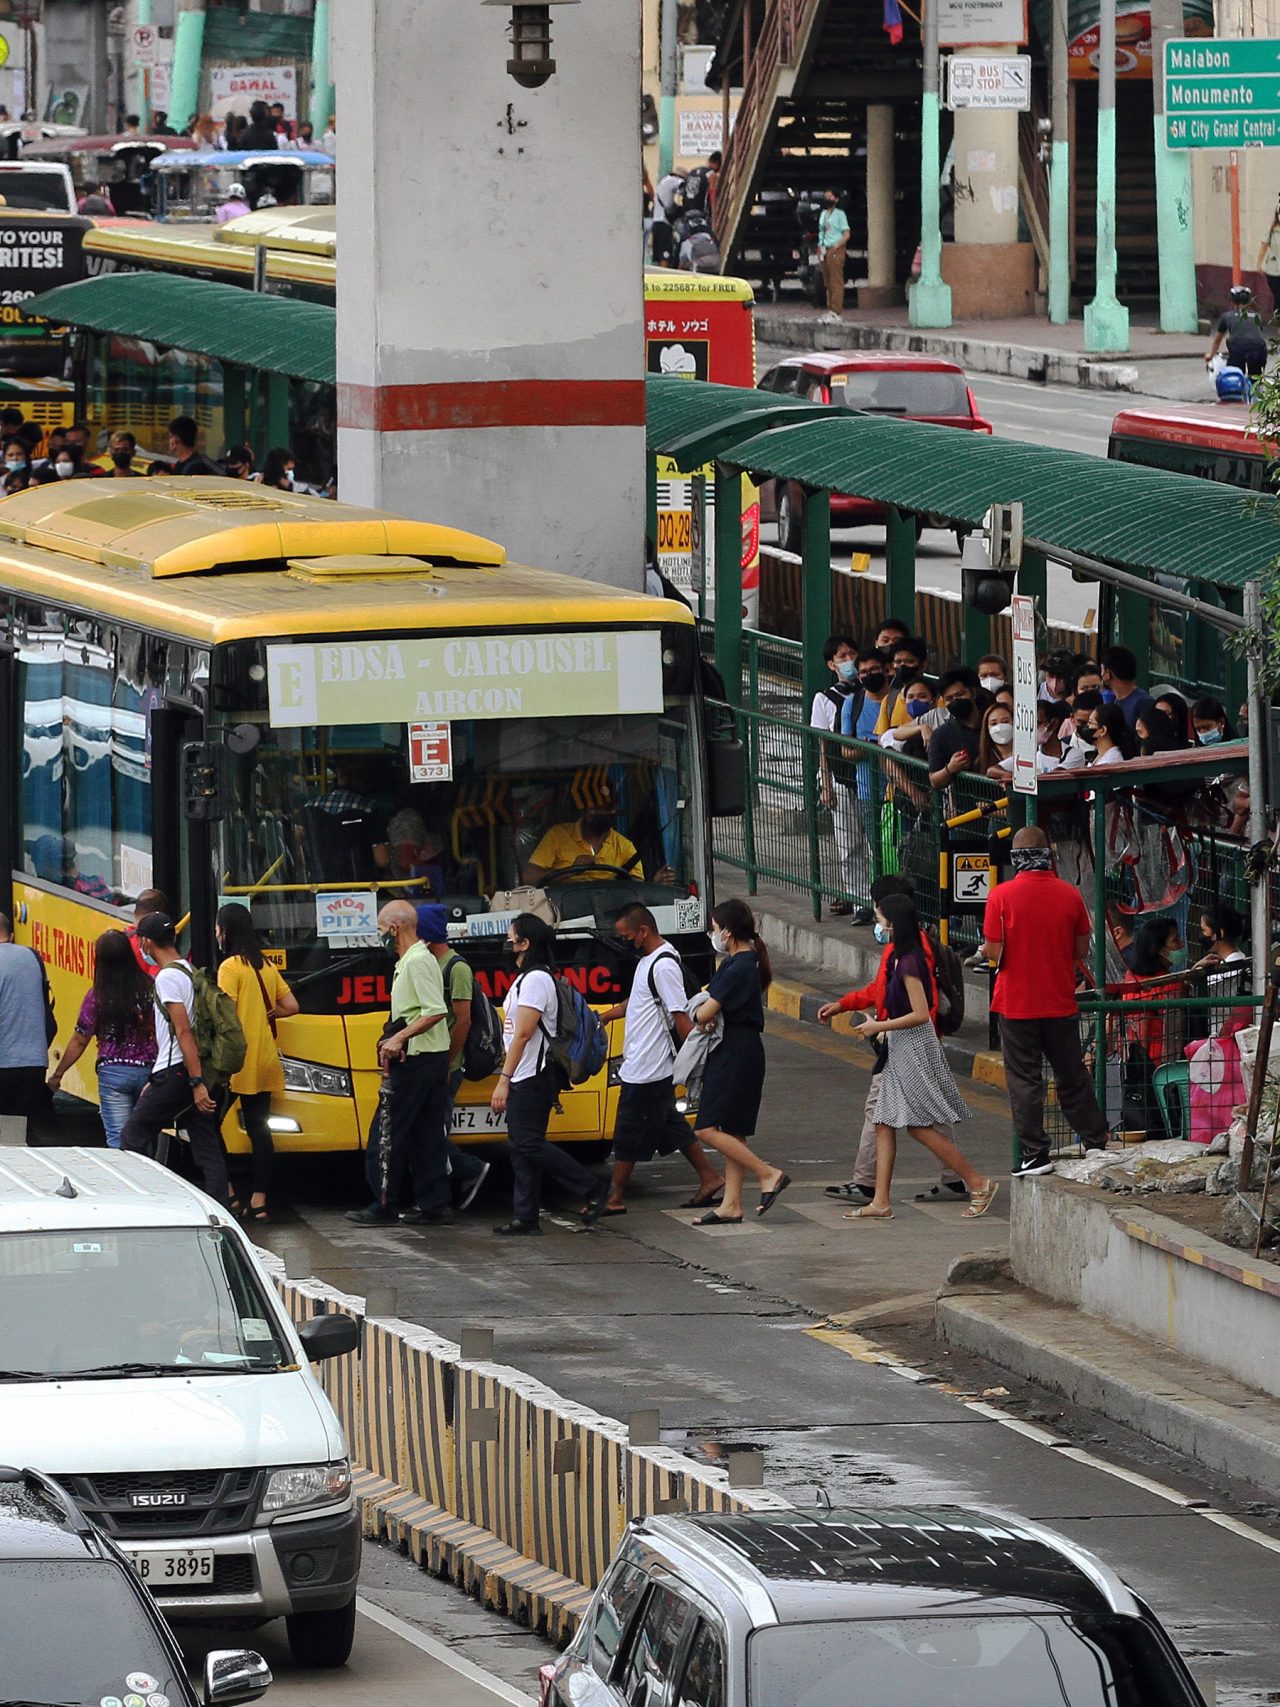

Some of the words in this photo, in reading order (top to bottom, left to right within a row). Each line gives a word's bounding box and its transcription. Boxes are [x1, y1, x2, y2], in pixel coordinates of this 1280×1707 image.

[1171, 48, 1230, 69] Malabon
[980, 65, 999, 77] BUS
[977, 79, 1002, 90] STOP
[1172, 84, 1253, 104] Monumento
[1171, 120, 1186, 138] SM
[1191, 119, 1209, 142] City
[1214, 119, 1239, 137] Grand
[1243, 118, 1275, 137] Central
[18, 231, 64, 245] YOUR
[651, 283, 661, 292] to
[698, 284, 711, 292] for
[713, 284, 737, 293] FREE
[647, 320, 676, 333] ホテル
[681, 319, 709, 333] ソウゴ
[319, 644, 407, 683] EDSA
[443, 636, 612, 678] CAROUSEL
[1017, 656, 1032, 685] Bus
[276, 661, 304, 708] E
[414, 687, 523, 716] AIRCON
[1016, 703, 1034, 740] Stop
[421, 740, 441, 764] E
[420, 766, 443, 776] 373
[327, 898, 365, 913] MOA
[53, 927, 85, 977] TRANS
[452, 1112, 476, 1128] NFZ
[132, 1494, 185, 1506] ISUZU
[164, 1557, 211, 1577] 3895
